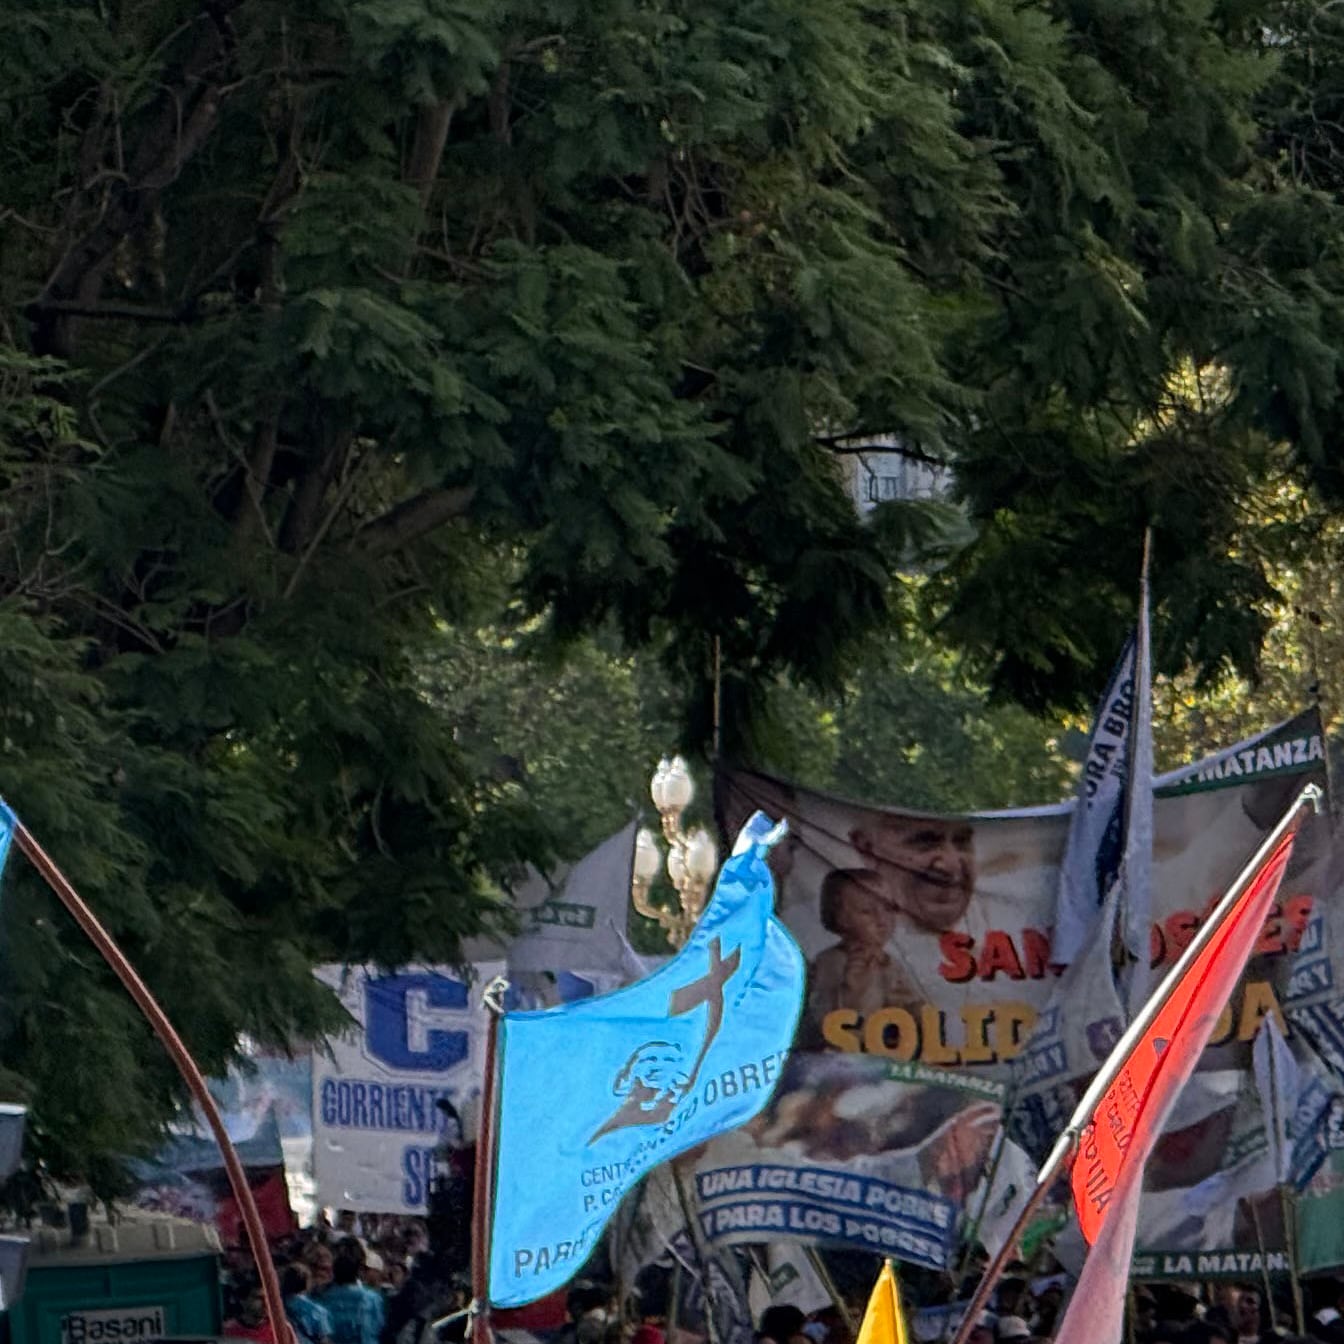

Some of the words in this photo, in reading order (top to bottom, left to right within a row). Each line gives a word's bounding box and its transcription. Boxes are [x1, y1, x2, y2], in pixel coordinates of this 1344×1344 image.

[703, 1169, 752, 1196] UNA
[757, 1168, 861, 1201] IGLESIA
[864, 1184, 949, 1228] POBRE
[716, 1205, 785, 1232] PARA
[788, 1206, 842, 1233] LOS
[1164, 1253, 1191, 1273] LA
[69, 1311, 162, 1340] Basani
